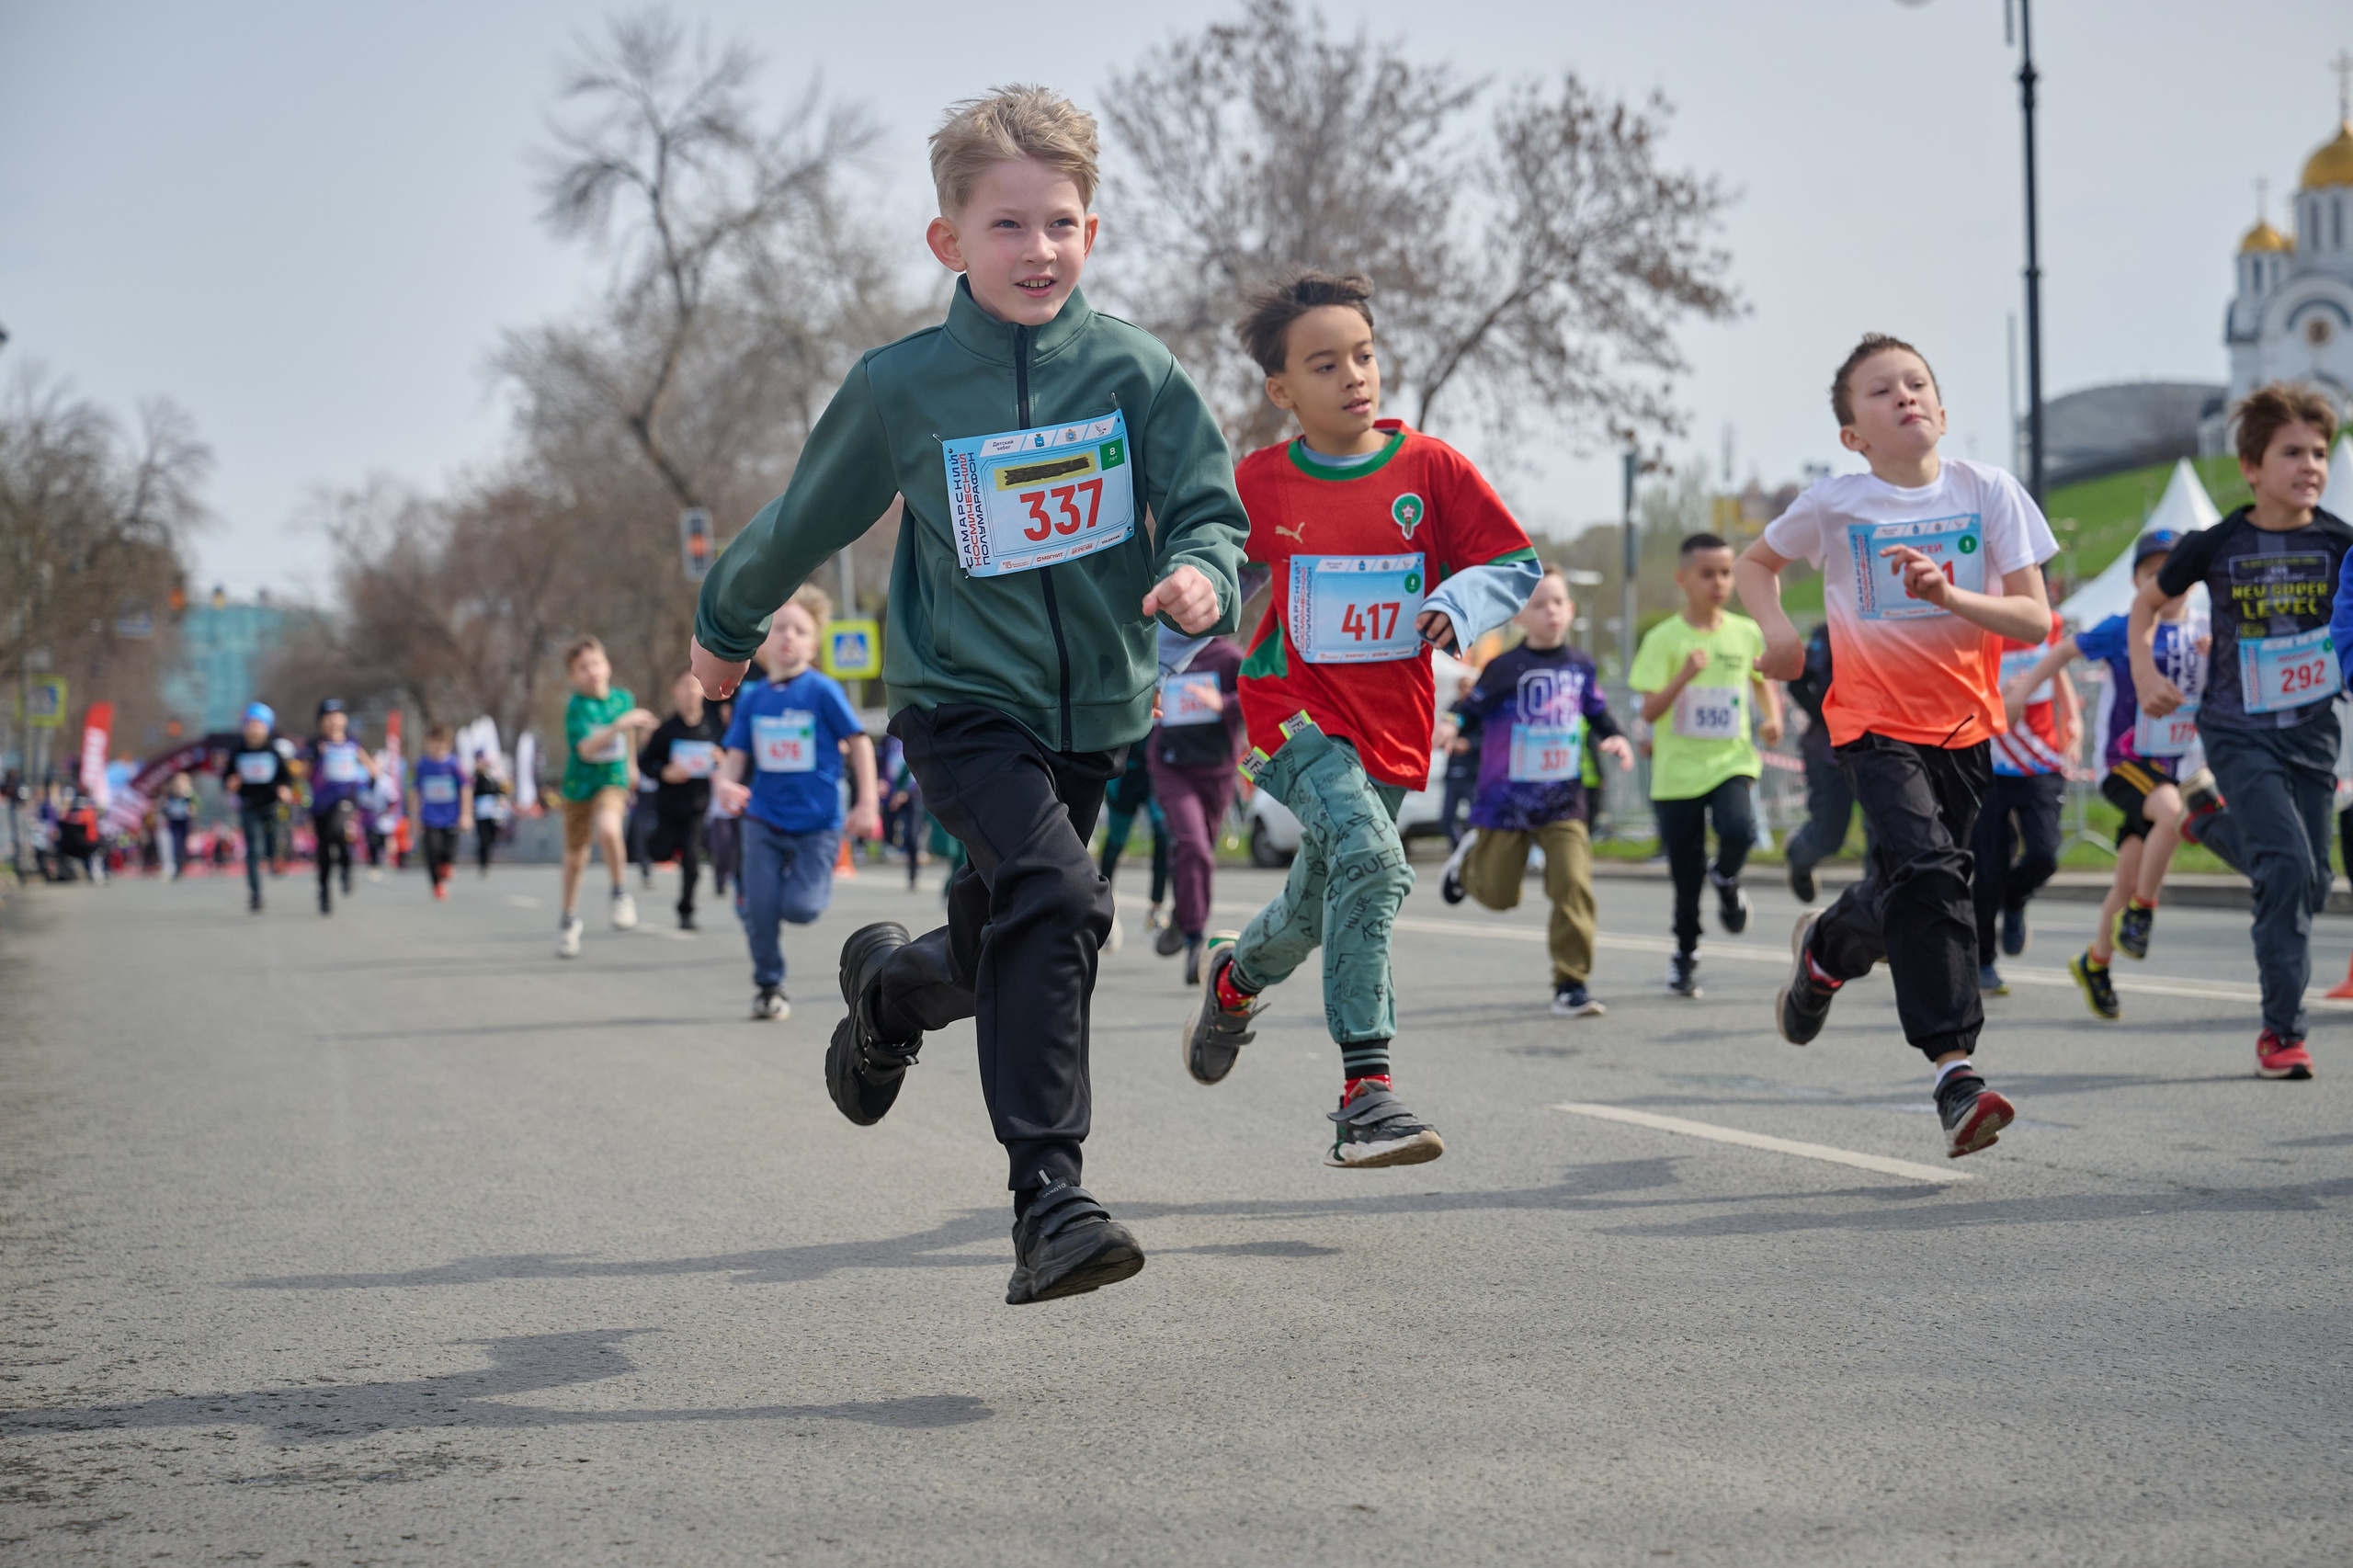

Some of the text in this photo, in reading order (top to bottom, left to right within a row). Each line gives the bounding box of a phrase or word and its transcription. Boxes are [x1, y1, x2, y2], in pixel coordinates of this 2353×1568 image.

[992, 439, 1014, 448] Детский
[1109, 447, 1116, 456] 8
[949, 454, 974, 570] САМАРСКИЙ
[958, 453, 983, 567] КОСМИЧЕСКИЙ
[968, 452, 991, 565] ПОЛУМАРАФОН
[1019, 477, 1103, 542] 337
[1341, 602, 1400, 642] 417
[2280, 659, 2326, 694] 292
[1346, 846, 1406, 882] QUEE
